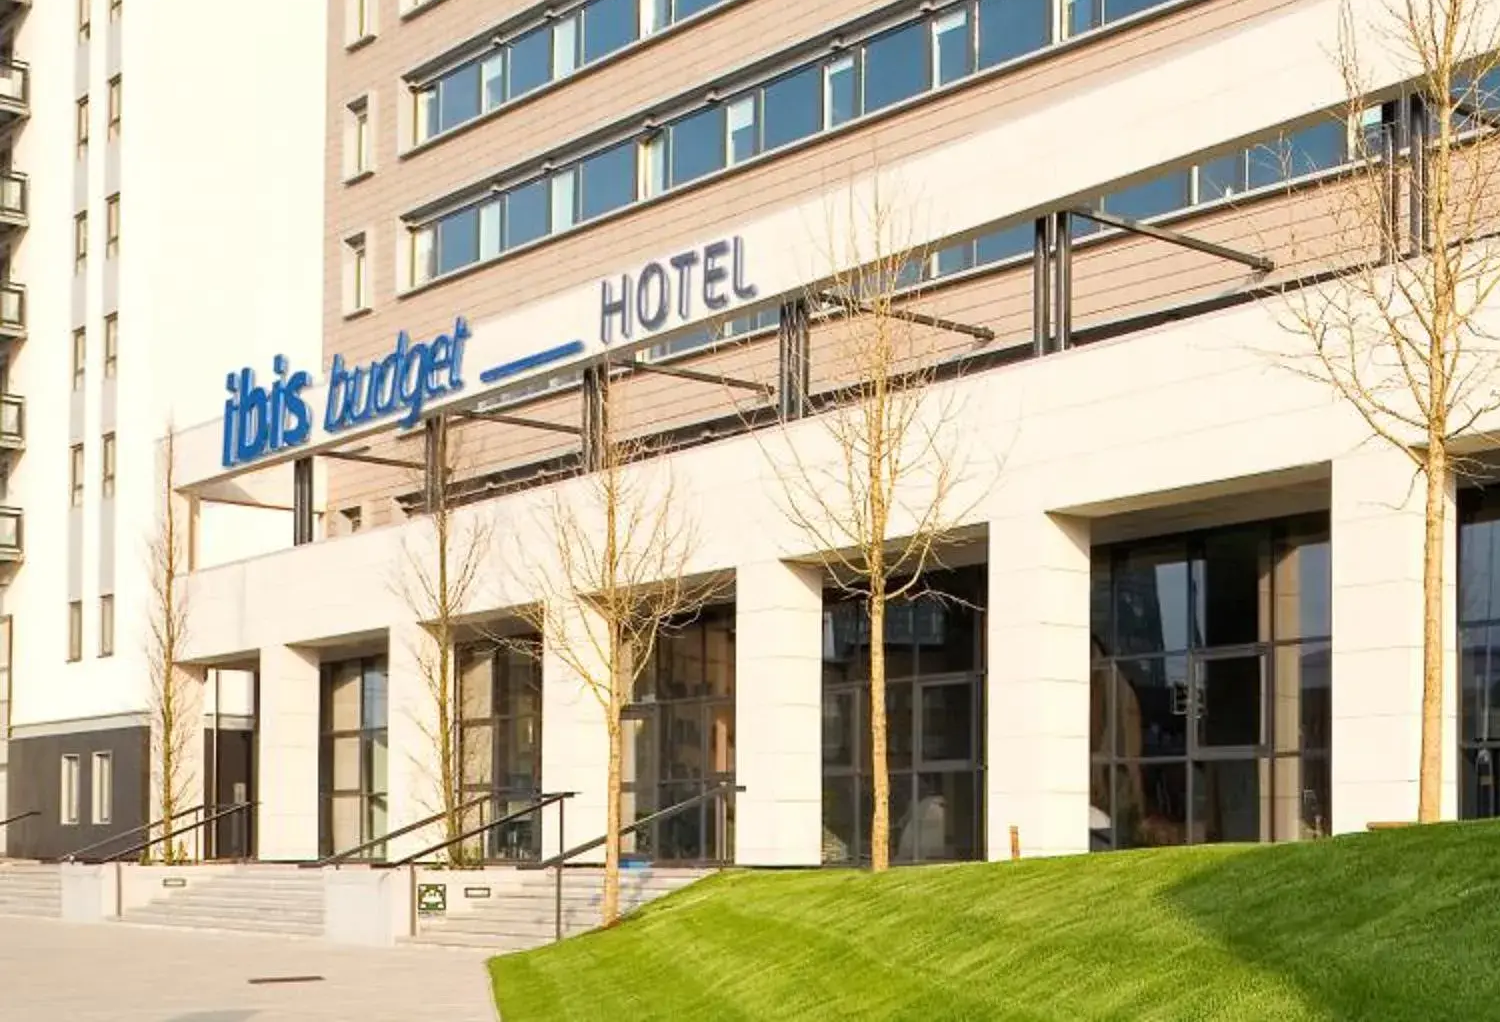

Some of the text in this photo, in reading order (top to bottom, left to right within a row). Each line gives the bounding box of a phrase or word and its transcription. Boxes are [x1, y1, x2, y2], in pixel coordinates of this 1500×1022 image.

[222, 235, 758, 467] ibis budget HOTEL
